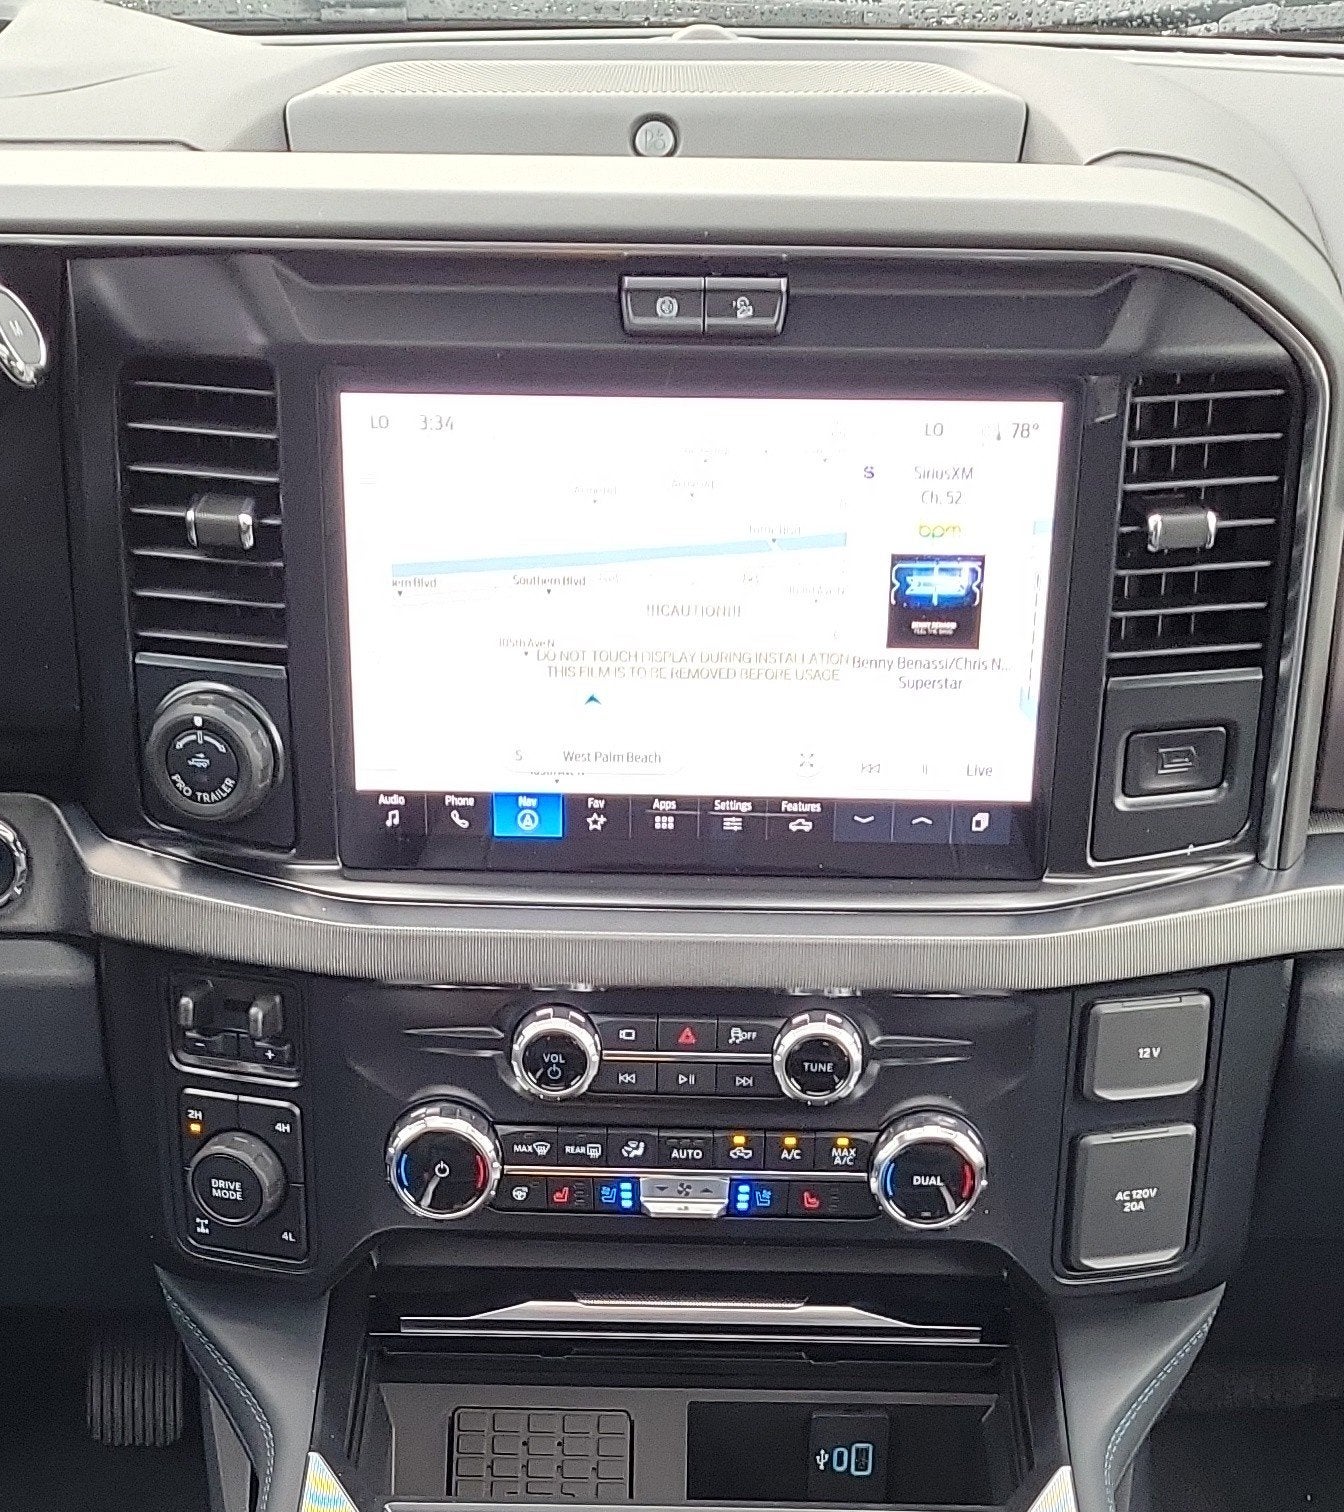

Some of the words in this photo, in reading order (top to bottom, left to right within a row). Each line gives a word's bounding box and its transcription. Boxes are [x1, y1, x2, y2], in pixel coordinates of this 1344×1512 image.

[370, 415, 390, 430] LO
[419, 415, 455, 431] 3:34
[924, 423, 944, 437] LO
[913, 466, 975, 481] SiriusXM
[945, 490, 964, 505] 52
[392, 576, 413, 588] ern
[512, 574, 560, 588] Southern
[562, 574, 587, 588] Blvd
[536, 649, 559, 663] DO
[560, 649, 587, 663] NOT
[592, 650, 638, 664] TOUCH
[641, 650, 698, 665] DISPLAY
[700, 651, 752, 666] DURING
[754, 651, 850, 667] INSTALLATION
[851, 656, 894, 673] Benny
[897, 655, 988, 672] Benassi/Chris
[546, 666, 576, 679] THIS
[579, 666, 610, 679] FILM
[612, 666, 626, 679] IS
[630, 667, 648, 680] TO
[650, 667, 667, 680] BE
[670, 667, 737, 681] REMOVED
[740, 668, 792, 682] BEFORE
[794, 668, 841, 682] USAGE
[898, 676, 963, 691] Superstar
[562, 750, 592, 763] West
[594, 751, 624, 764] Palm
[626, 751, 663, 765] Beach
[966, 764, 993, 778] Live
[171, 773, 193, 797] PRO
[195, 777, 236, 803] TRAILER
[378, 794, 405, 806] Audio
[444, 795, 475, 807] Phone
[518, 796, 537, 808] Nav
[587, 797, 605, 809] Fav
[652, 798, 677, 812] Apps
[714, 799, 753, 813] Settings
[781, 801, 822, 813] Features
[740, 1030, 758, 1041] OFF
[543, 1053, 565, 1064] VOL
[802, 1061, 833, 1074] TUNE
[187, 1110, 203, 1121] 2H
[274, 1122, 291, 1134] 4H
[512, 1143, 533, 1154] MAX
[565, 1145, 585, 1155] REAR
[670, 1148, 703, 1160] AUTO
[830, 1147, 855, 1158] MAX
[781, 1149, 802, 1161] A/C
[832, 1156, 854, 1167] A/C
[211, 1179, 243, 1191] DRIVE
[912, 1175, 944, 1186] DUAL
[211, 1188, 244, 1201] MODE
[1115, 1190, 1131, 1201] AC
[1131, 1187, 1158, 1199] 120V
[1123, 1200, 1146, 1213] 20A
[281, 1231, 296, 1243] 4L
